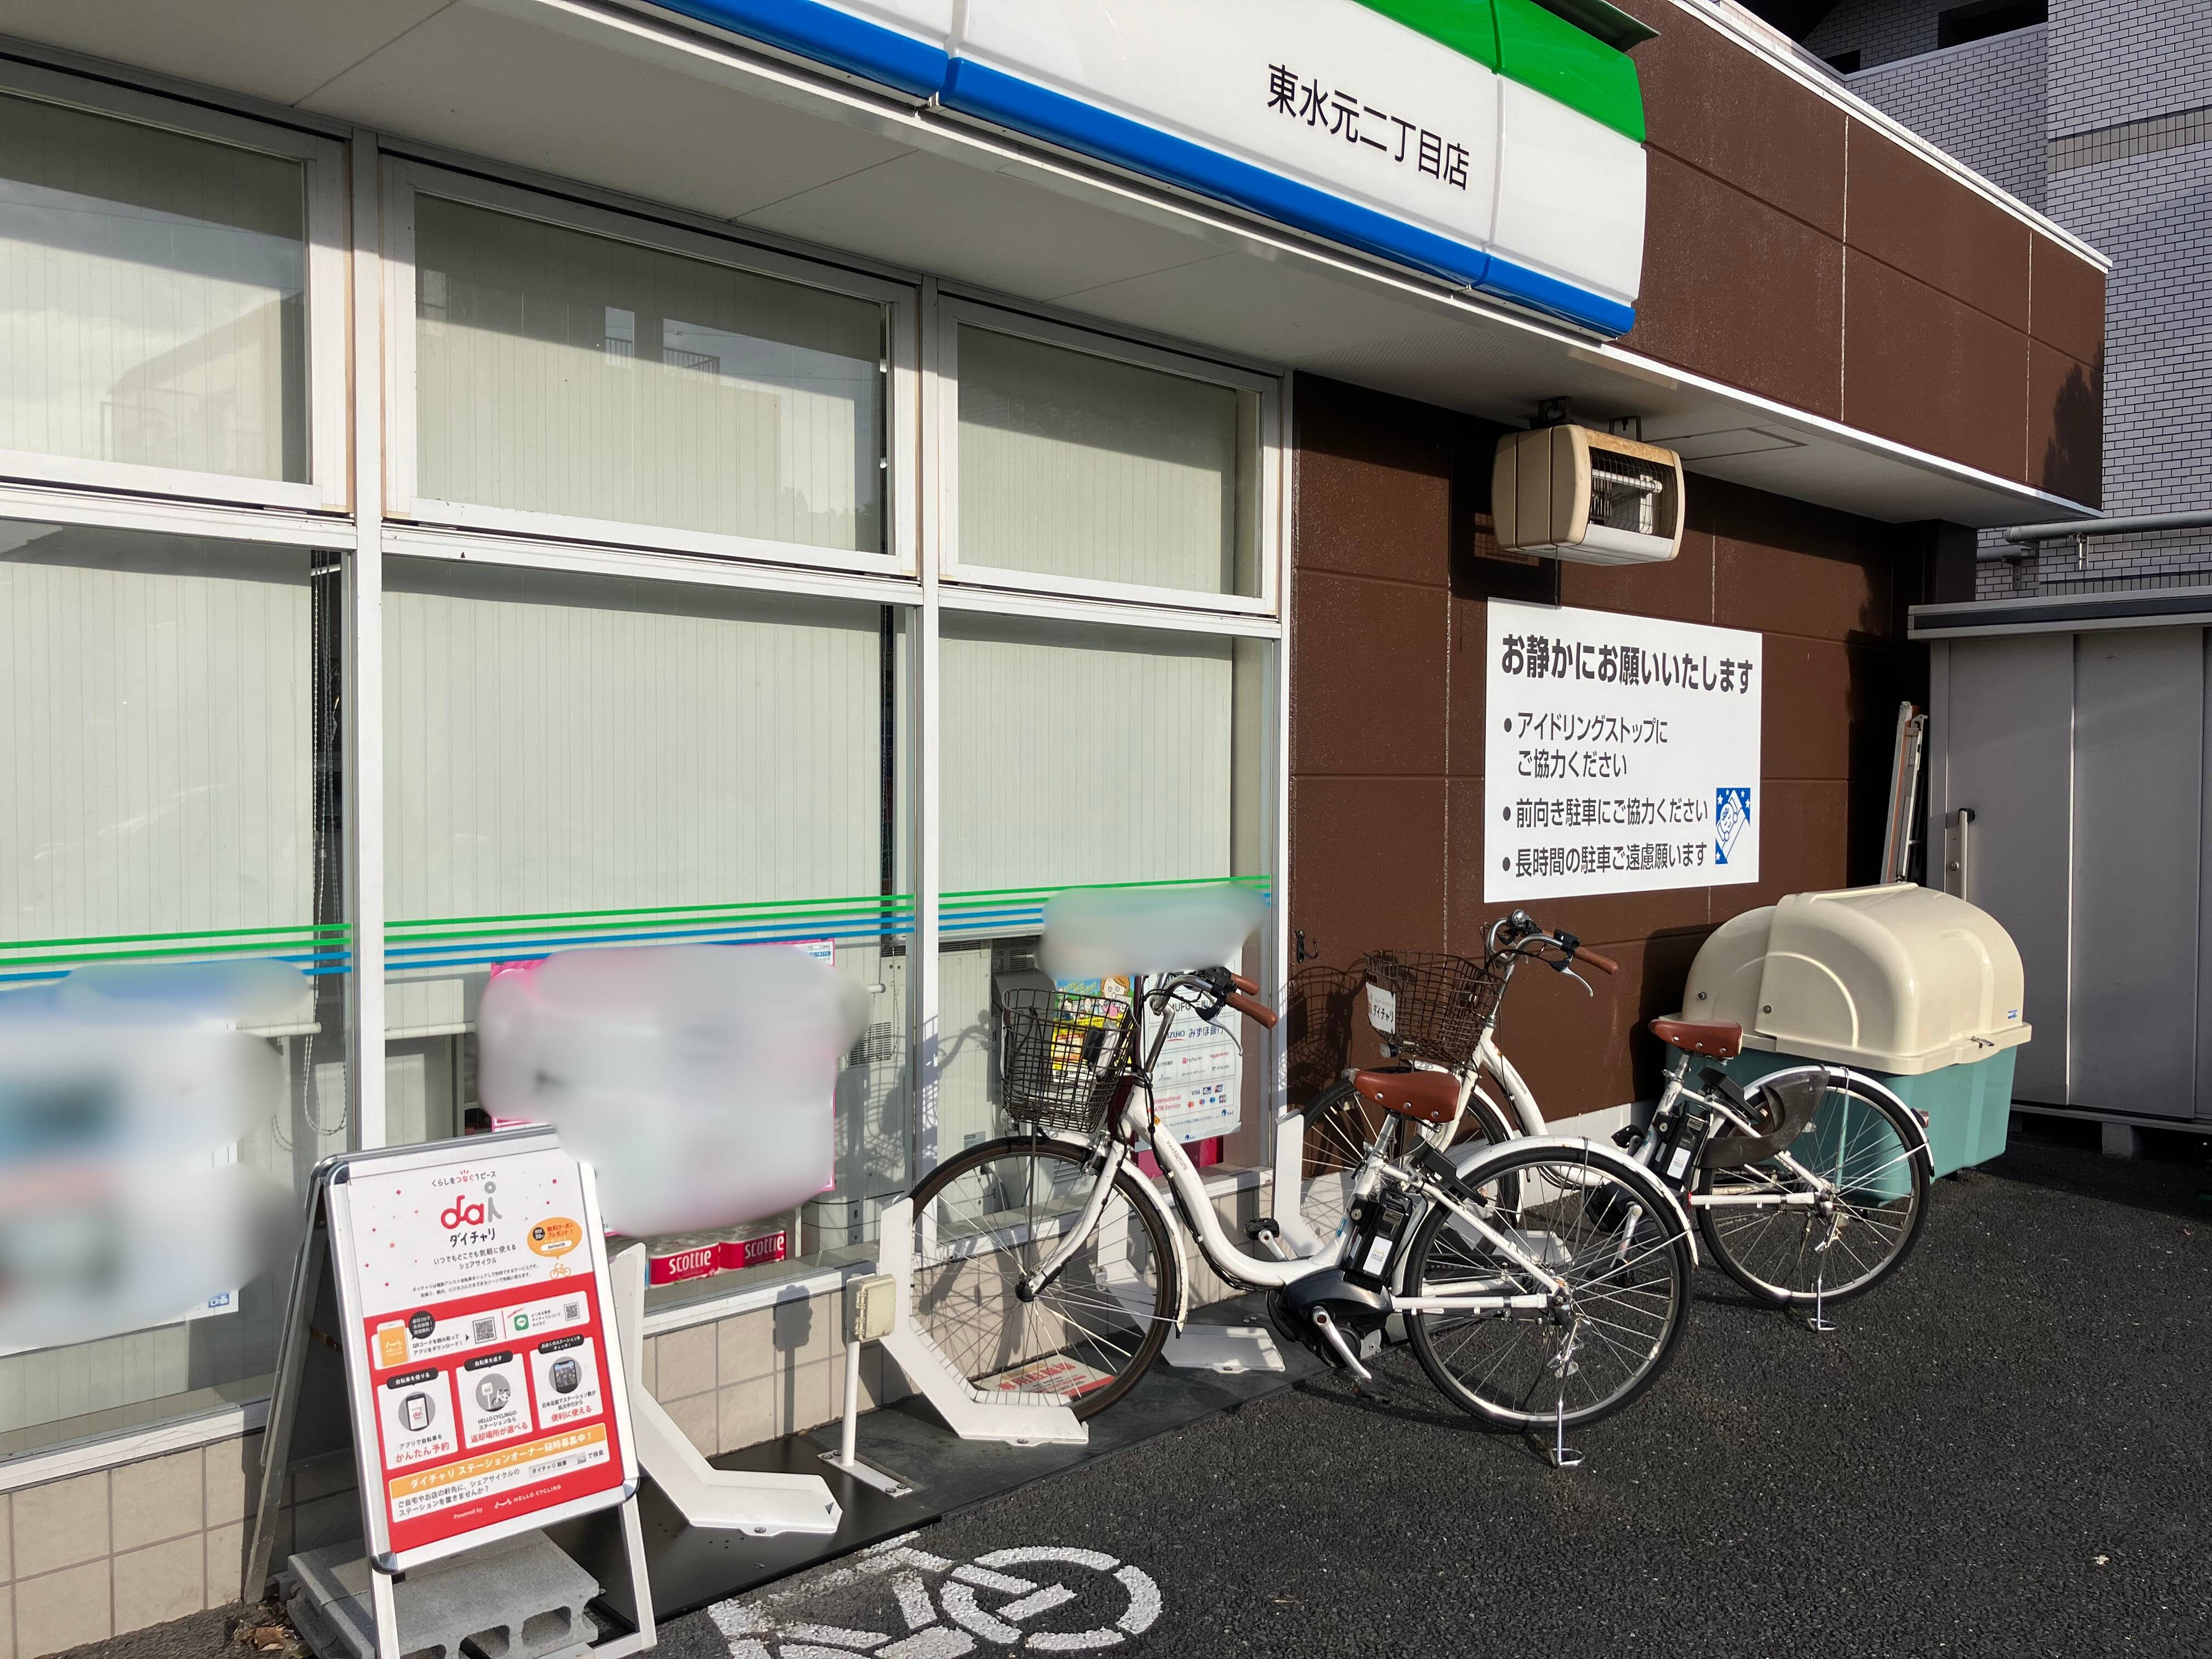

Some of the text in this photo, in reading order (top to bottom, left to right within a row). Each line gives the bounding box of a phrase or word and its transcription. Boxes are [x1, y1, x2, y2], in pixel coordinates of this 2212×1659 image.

[1267, 64, 1469, 190] 東水元二丁目店
[1502, 634, 1753, 694] お静かにお願いいたします
[1517, 713, 1668, 744] アイドリングストップに
[1517, 748, 1627, 779] ご協力ください
[1516, 797, 1708, 828] 前向き駐車にご協力ください
[1516, 842, 1707, 878] 長時間の駐車ご遠慮願います
[1167, 1030, 1185, 1039] IZUHO
[432, 1171, 496, 1187] くらしをつなぐ1ピース
[441, 1181, 502, 1229] dai
[449, 1228, 495, 1248] ダイチャリ
[744, 1235, 784, 1259] scottie
[433, 1244, 516, 1265] いつでもどこでも気軽に使える
[459, 1257, 497, 1269] シェアサイクル
[669, 1250, 712, 1274] scottie
[475, 1356, 503, 1367] 自転車を返す
[396, 1372, 430, 1385] 自転車を借りる
[479, 1417, 516, 1430] ステーションなら
[551, 1406, 592, 1423] 便利に使える
[400, 1434, 442, 1449] アプリで自転車を
[471, 1422, 528, 1443] 返却場所が選べる
[396, 1441, 450, 1463] かんたん予約
[411, 1431, 591, 1489] ダイチャリ ステーションオーナー随時募集中！
[588, 1449, 604, 1459] で検索
[399, 1486, 489, 1517] ステーションを置きませんか？
[514, 1484, 562, 1502] HELLO CYCLING
[453, 1509, 476, 1519] Powered
